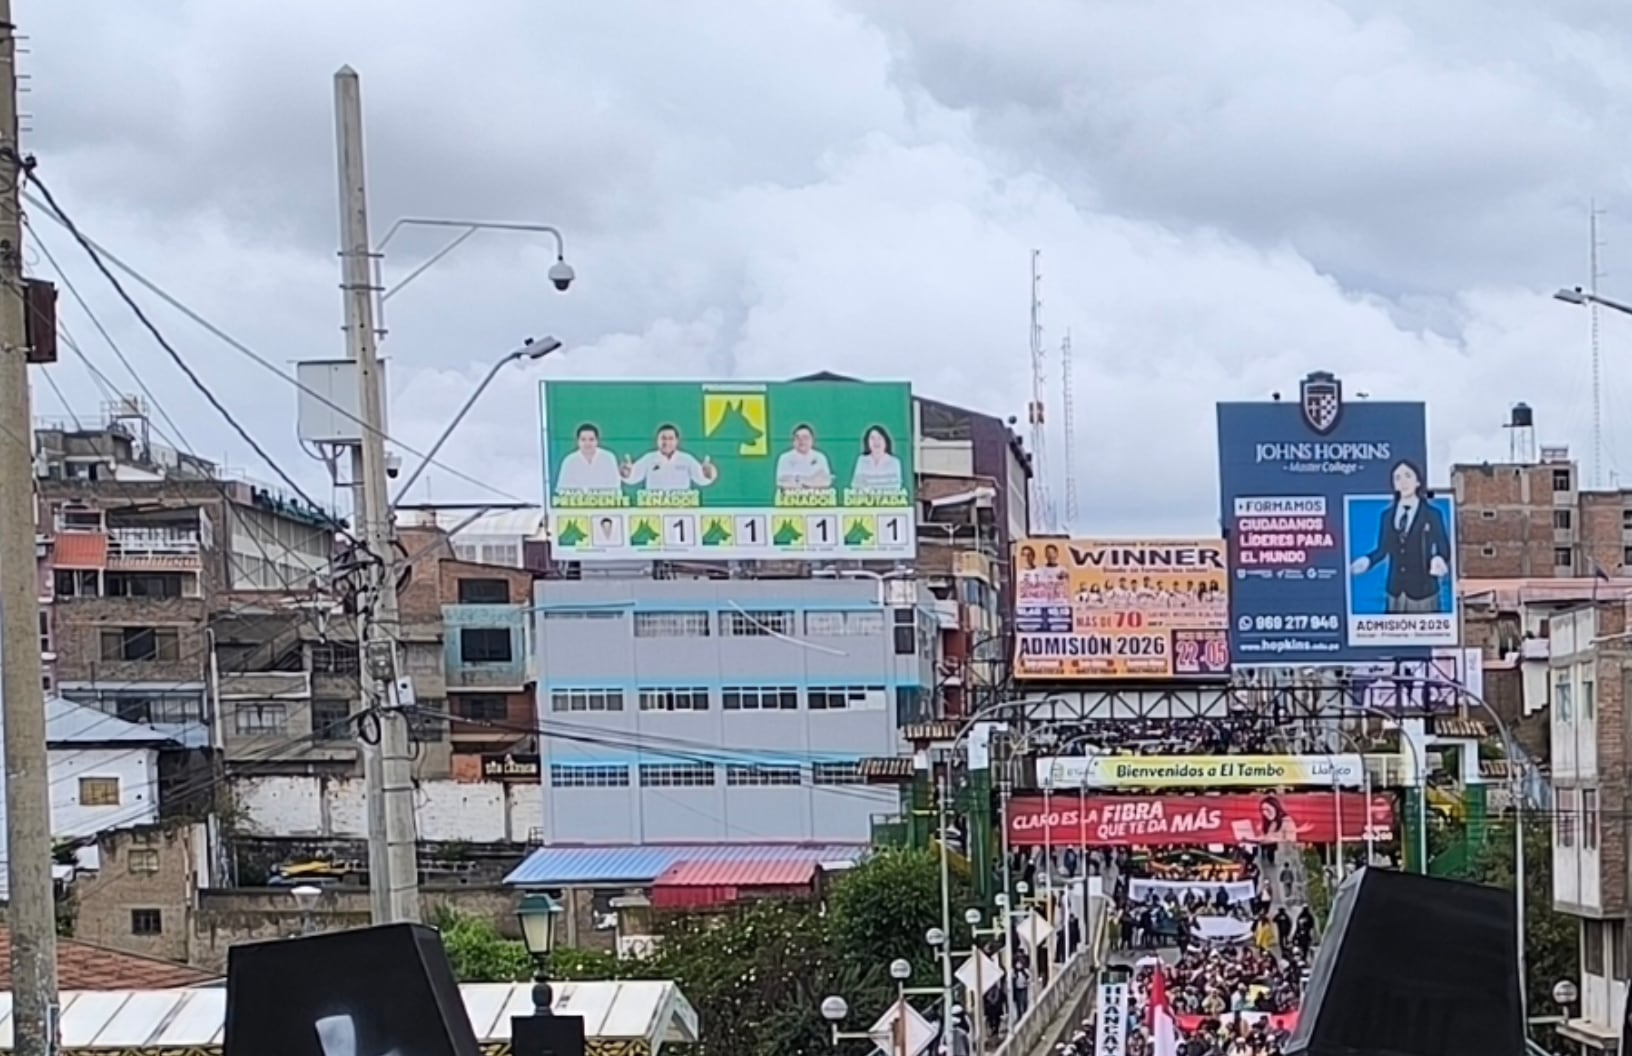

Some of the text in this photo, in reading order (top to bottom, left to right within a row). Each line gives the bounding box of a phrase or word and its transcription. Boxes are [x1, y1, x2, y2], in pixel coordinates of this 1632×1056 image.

[1256, 442, 1391, 462] JOHNS HOPKINS
[1322, 461, 1357, 474] College
[1246, 501, 1322, 512] FORMAMOS
[673, 519, 685, 542] 1
[745, 519, 757, 542] 1
[816, 519, 828, 542] 1
[887, 518, 898, 541] 1
[1240, 518, 1323, 531] CIUDADANOS
[1296, 534, 1333, 546] PARA
[1069, 547, 1224, 569] WINNER
[1241, 551, 1306, 563] EL MUNDO
[1115, 611, 1142, 628] 70
[1284, 615, 1308, 630] 217
[1357, 619, 1450, 631] ADMISIÓN 2026
[1020, 635, 1164, 655] ADMISIÓN 2026
[1116, 763, 1285, 778] Bienvenidos a El Tambo
[1012, 811, 1060, 830] CLARO
[1061, 810, 1079, 826] ES
[1101, 800, 1164, 823] FIBRA
[1097, 806, 1222, 840] QUE TE DA MÁS
